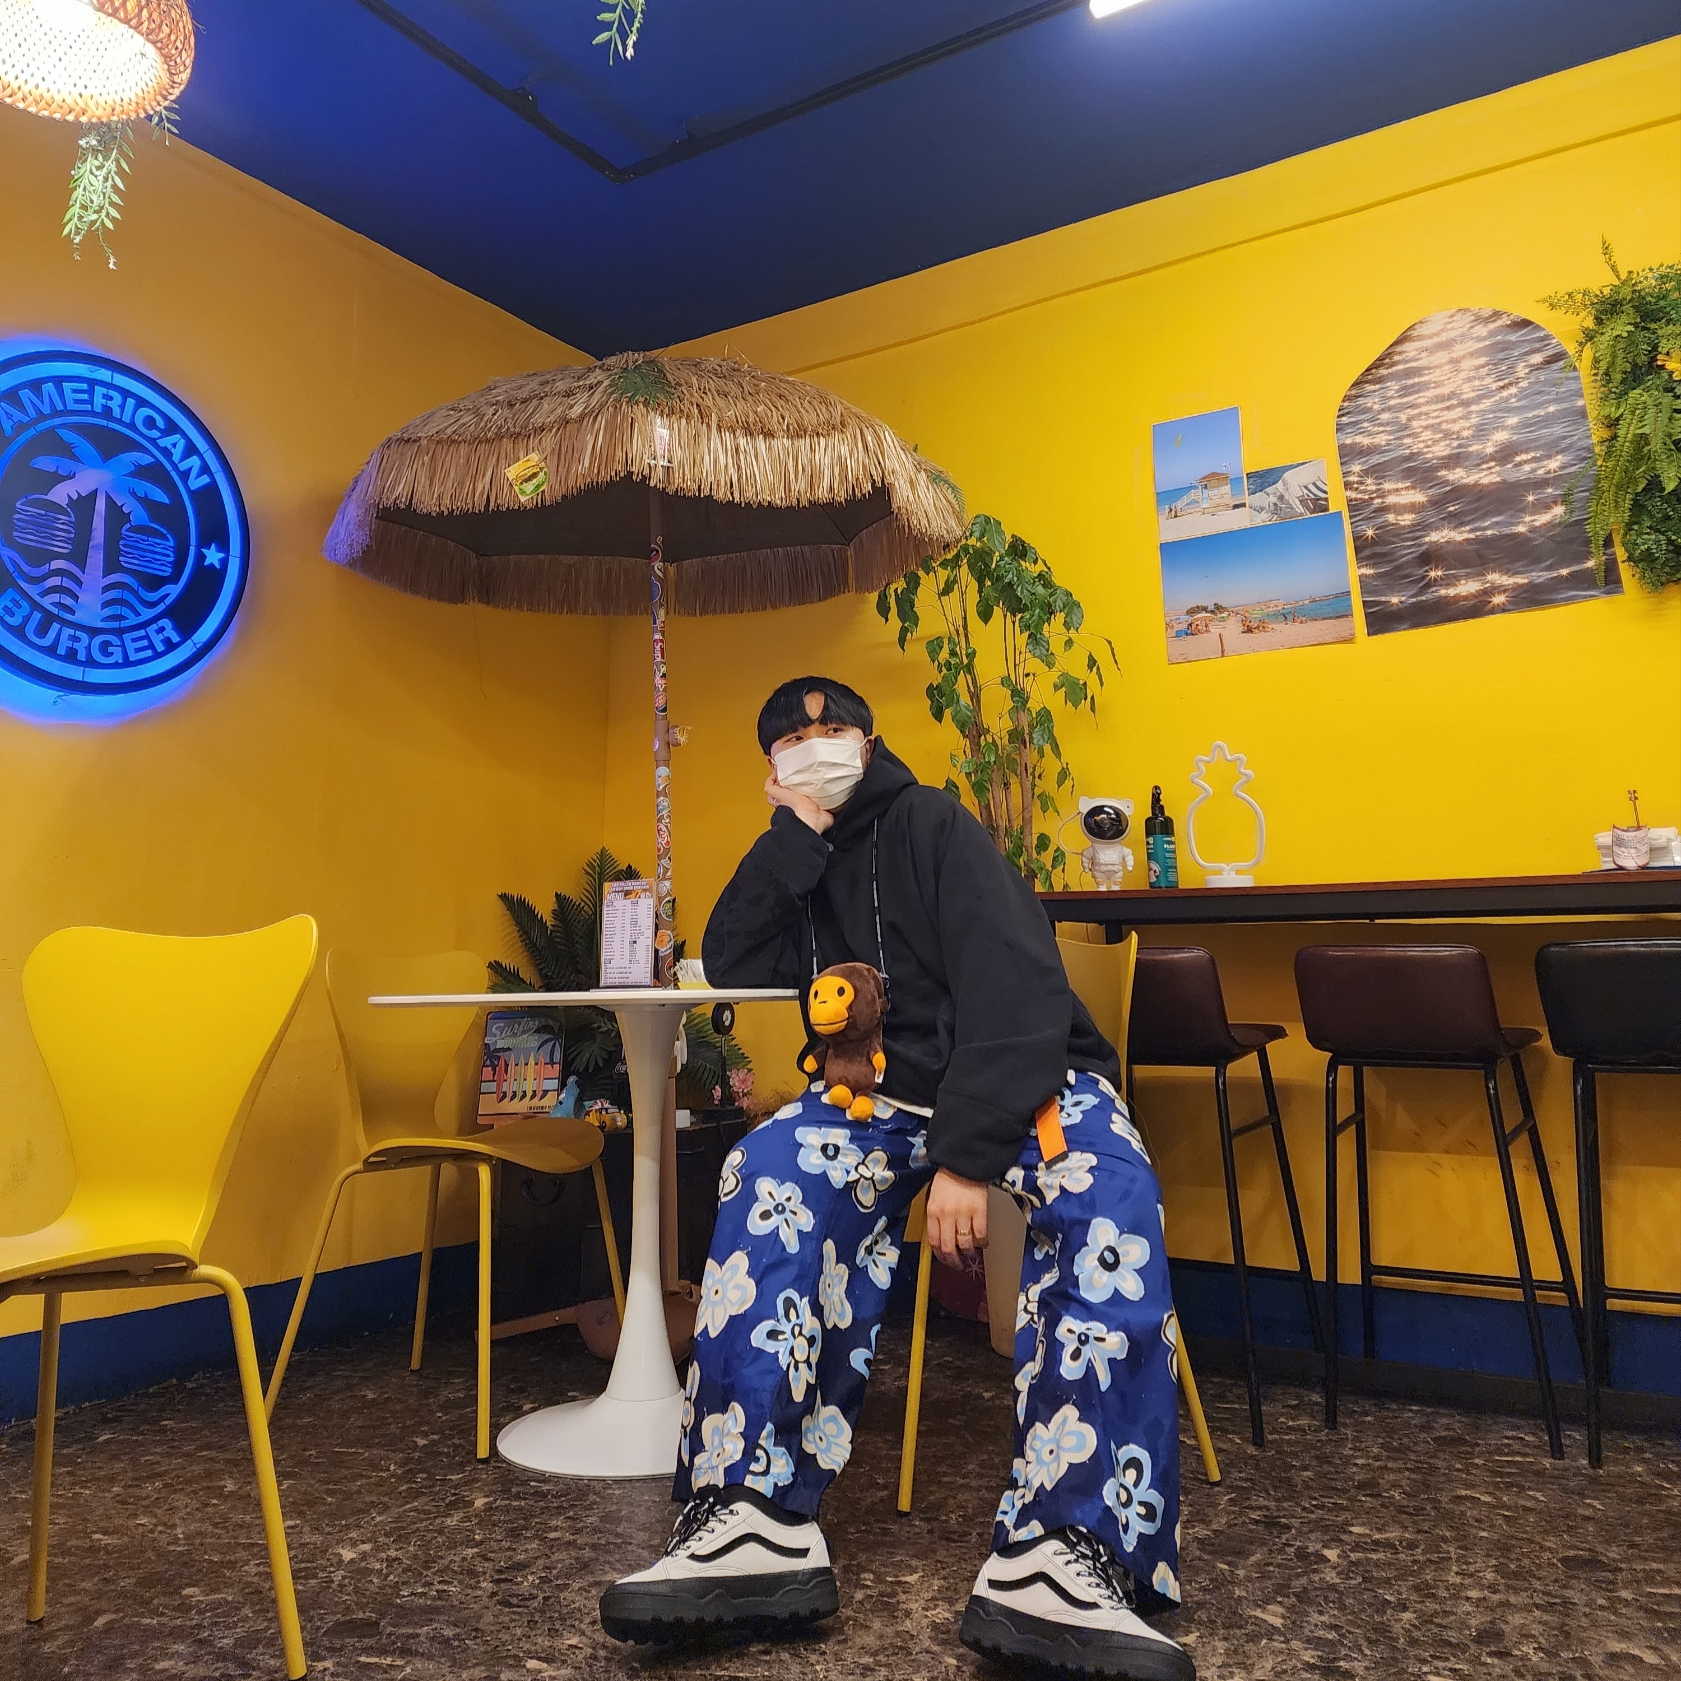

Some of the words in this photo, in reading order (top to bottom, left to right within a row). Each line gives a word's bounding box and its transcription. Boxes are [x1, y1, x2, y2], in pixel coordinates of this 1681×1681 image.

[0, 381, 211, 492] AMERICAN
[0, 586, 182, 665] BURGER
[485, 1017, 539, 1043] Surfing
